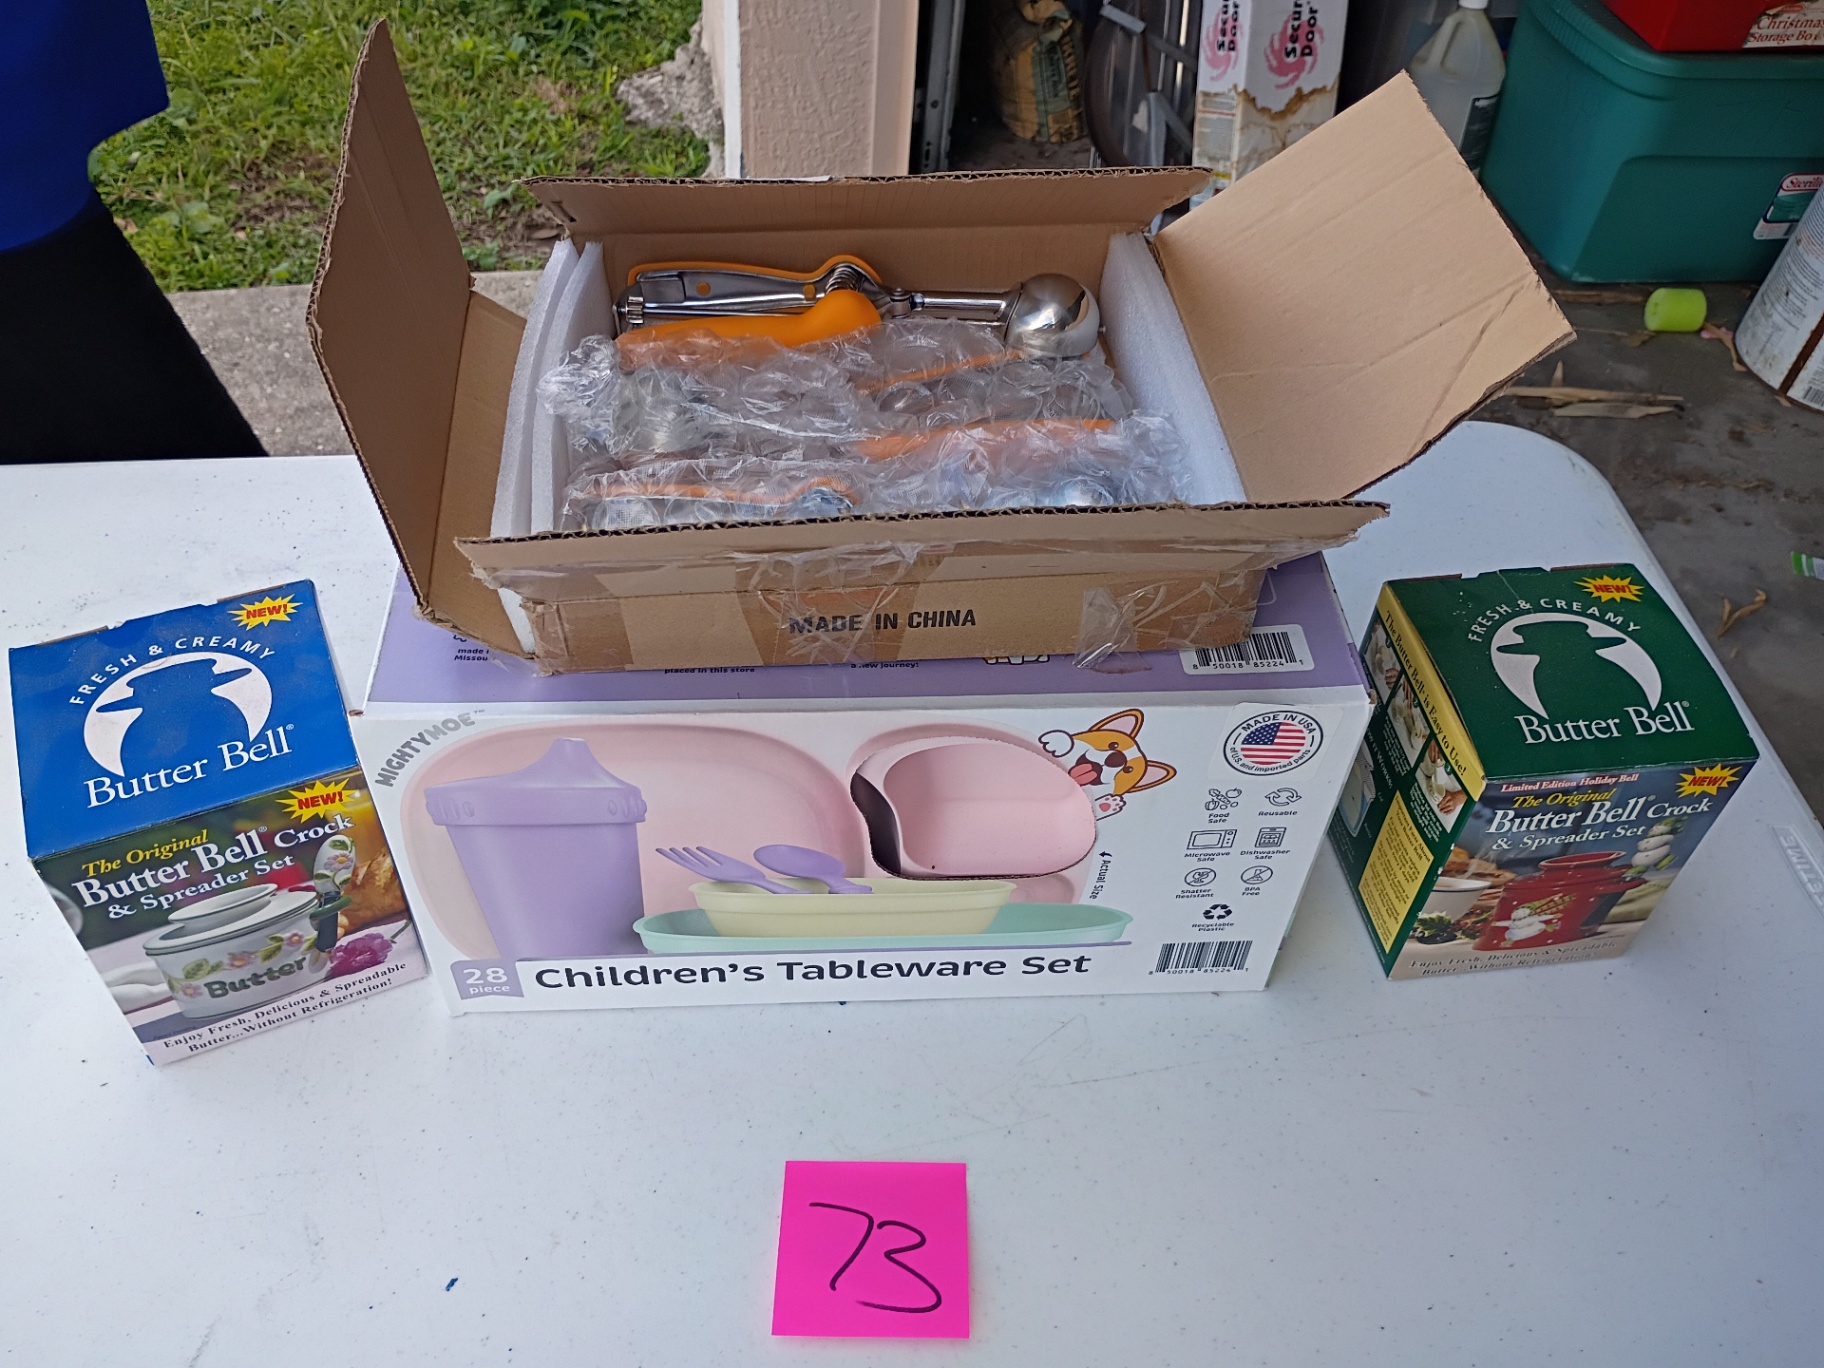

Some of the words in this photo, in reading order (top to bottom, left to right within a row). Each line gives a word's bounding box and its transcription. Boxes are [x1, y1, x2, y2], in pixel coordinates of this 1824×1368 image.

[1217, 0, 1229, 51] Secu
[1301, 6, 1318, 57] Door
[1593, 583, 1632, 594] NEW!
[246, 603, 288, 619] NEW!
[789, 614, 863, 634] MADE
[875, 613, 898, 630] IN
[907, 609, 977, 629] CHINA
[1468, 603, 1513, 643] FRESH
[1519, 599, 1532, 610] &
[1540, 598, 1641, 632] CREAMY
[69, 654, 137, 705] FRESH
[149, 645, 163, 656] &
[175, 636, 275, 660] CREAMY
[1212, 662, 1244, 670] 50018
[1253, 660, 1285, 668] 85224
[1386, 610, 1396, 636] The
[1395, 634, 1413, 669] Butter
[1423, 695, 1431, 709] is
[1429, 706, 1444, 735] Easy
[1441, 734, 1451, 750] to
[1450, 749, 1467, 776] Use!
[1241, 714, 1280, 732] MADE
[1283, 714, 1298, 722] IN
[1298, 717, 1316, 734] USA
[1514, 715, 1622, 744] Butter
[1240, 762, 1255, 771] and
[1254, 761, 1293, 772] imported
[1294, 749, 1311, 764] parts
[84, 758, 208, 809] Butter
[1500, 781, 1541, 793] Limited
[1541, 780, 1577, 790] Edition
[1579, 775, 1619, 787] Holiday
[1619, 773, 1640, 783] Bell
[1687, 776, 1726, 787] NEW!
[297, 791, 344, 810] NEW!
[1511, 795, 1543, 809] The
[1546, 788, 1618, 807] Original
[1258, 809, 1298, 817] Reusable
[1486, 809, 1583, 834] Butter
[1647, 798, 1714, 819] Crock
[1492, 837, 1513, 850] &
[1519, 829, 1610, 851] Spreader
[1612, 824, 1647, 838] Set
[71, 860, 189, 908] Butter
[274, 813, 356, 849] Crock
[82, 858, 122, 878] The
[126, 829, 209, 864] Original
[1095, 859, 1111, 883] Actual
[108, 903, 137, 920] &
[140, 869, 249, 910] Spreader
[254, 854, 296, 876] Set
[1089, 884, 1104, 899] Size
[203, 956, 307, 999] Butter
[463, 967, 508, 985] 28
[535, 963, 765, 988] Children's
[776, 960, 1007, 981] Tableware
[1021, 955, 1092, 975] Set
[301, 977, 392, 1015] Refrigeration!
[469, 983, 510, 996] piece
[164, 1032, 203, 1048] Enjoy
[208, 1014, 252, 1036] Fresh,
[254, 996, 316, 1020] Delicious
[319, 989, 331, 998] &
[334, 961, 407, 992] Spreadable
[809, 1202, 942, 1313] 73
